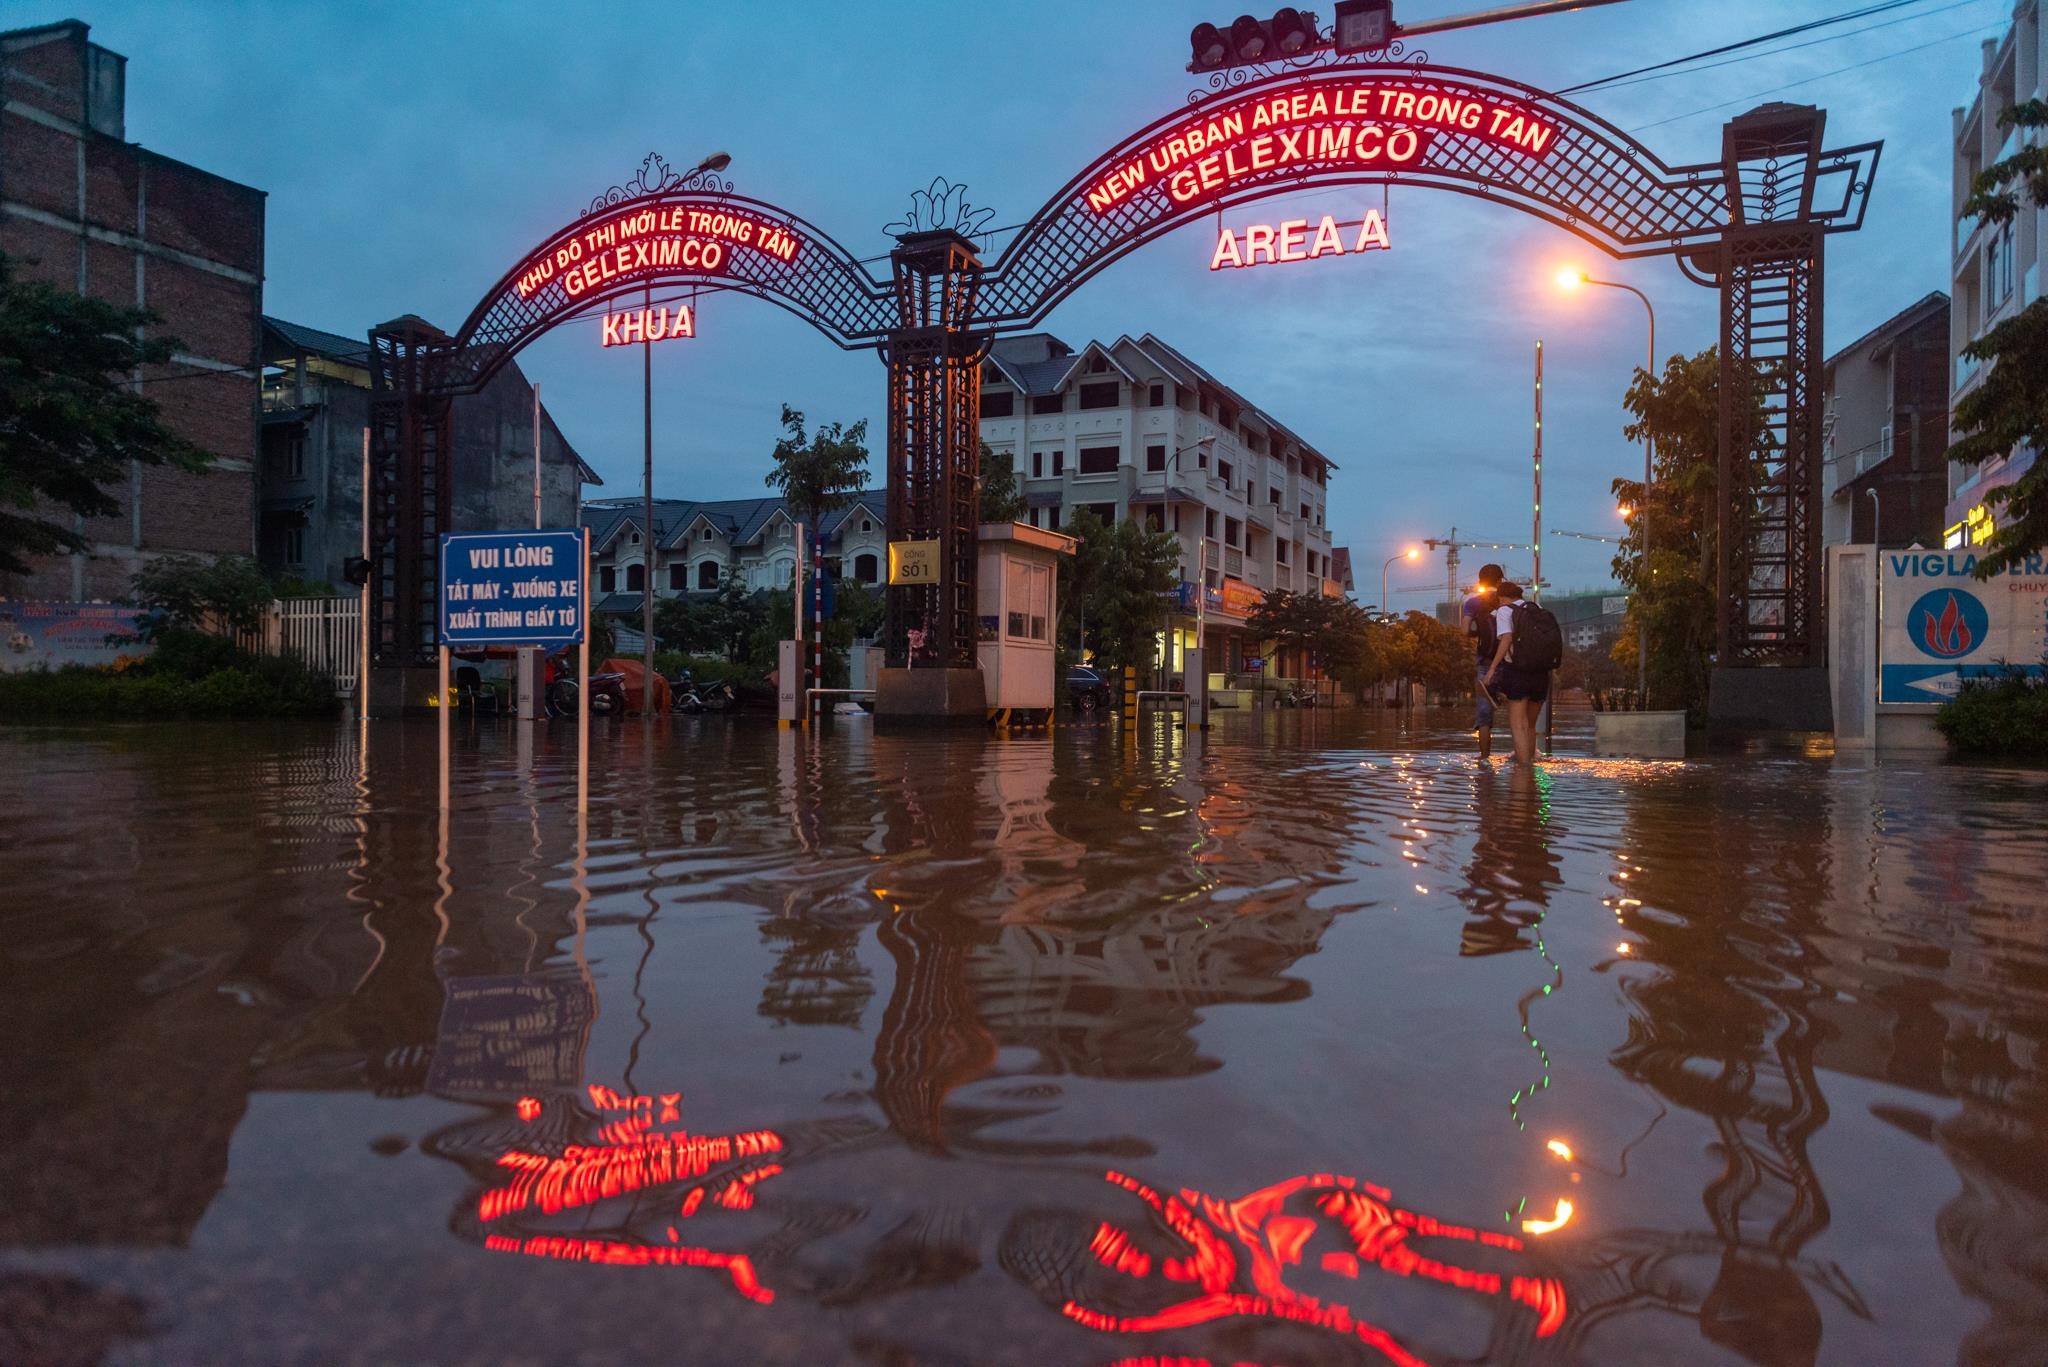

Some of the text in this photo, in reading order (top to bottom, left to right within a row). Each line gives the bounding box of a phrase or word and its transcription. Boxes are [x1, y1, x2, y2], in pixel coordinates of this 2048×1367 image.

[1088, 89, 1551, 212] NEW URBAN AREA LE TRONG TAN
[1171, 126, 1418, 201] GELEXIMCO
[518, 206, 796, 297] KHU ĐÔ THỊ MỚI LÊ TRỌNG TẤN
[1210, 209, 1390, 270] AREA A
[565, 240, 722, 296] GELEXIMCO
[602, 304, 695, 346] KHU A
[469, 542, 553, 569] VUI LÒNG
[902, 559, 928, 577] SỐ 1
[472, 580, 500, 600] MÁY
[512, 575, 557, 599] XUỐNG
[560, 580, 577, 597] XE
[449, 606, 482, 629] XUẤT
[525, 604, 555, 627] GIẤY
[558, 605, 576, 626] TỜ
